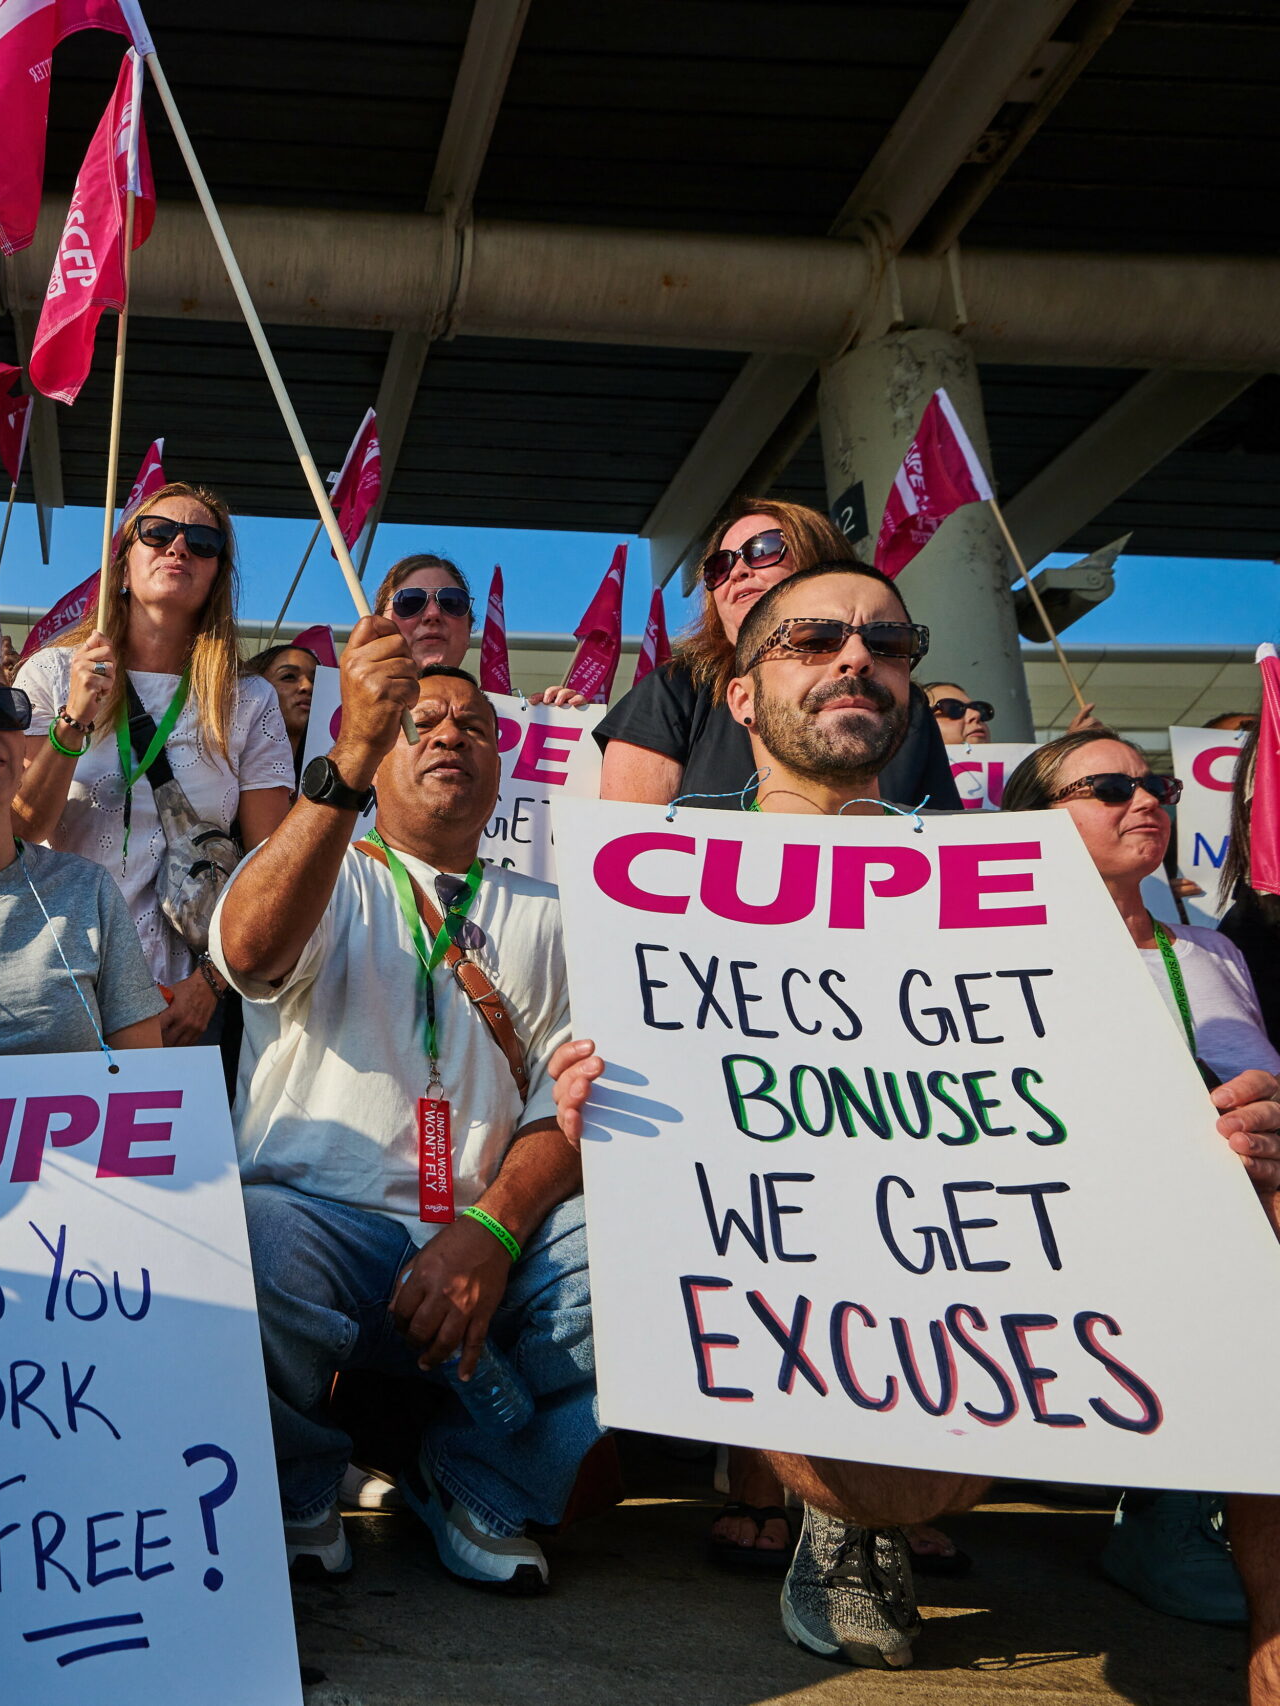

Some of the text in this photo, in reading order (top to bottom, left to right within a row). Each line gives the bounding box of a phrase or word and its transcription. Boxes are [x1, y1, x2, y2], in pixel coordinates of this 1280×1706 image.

[592, 831, 1048, 930] CUPE
[634, 942, 1054, 1046] EXECS GET
[425, 1110, 436, 1160] WON'T
[721, 1053, 1069, 1146] BONUSES
[425, 1163, 437, 1192] FLY
[436, 1112, 448, 1194] UNPAID WORK
[694, 1161, 1070, 1275] WE GET
[28, 1220, 152, 1323] YOU
[679, 1274, 1165, 1437] EXCUSES
